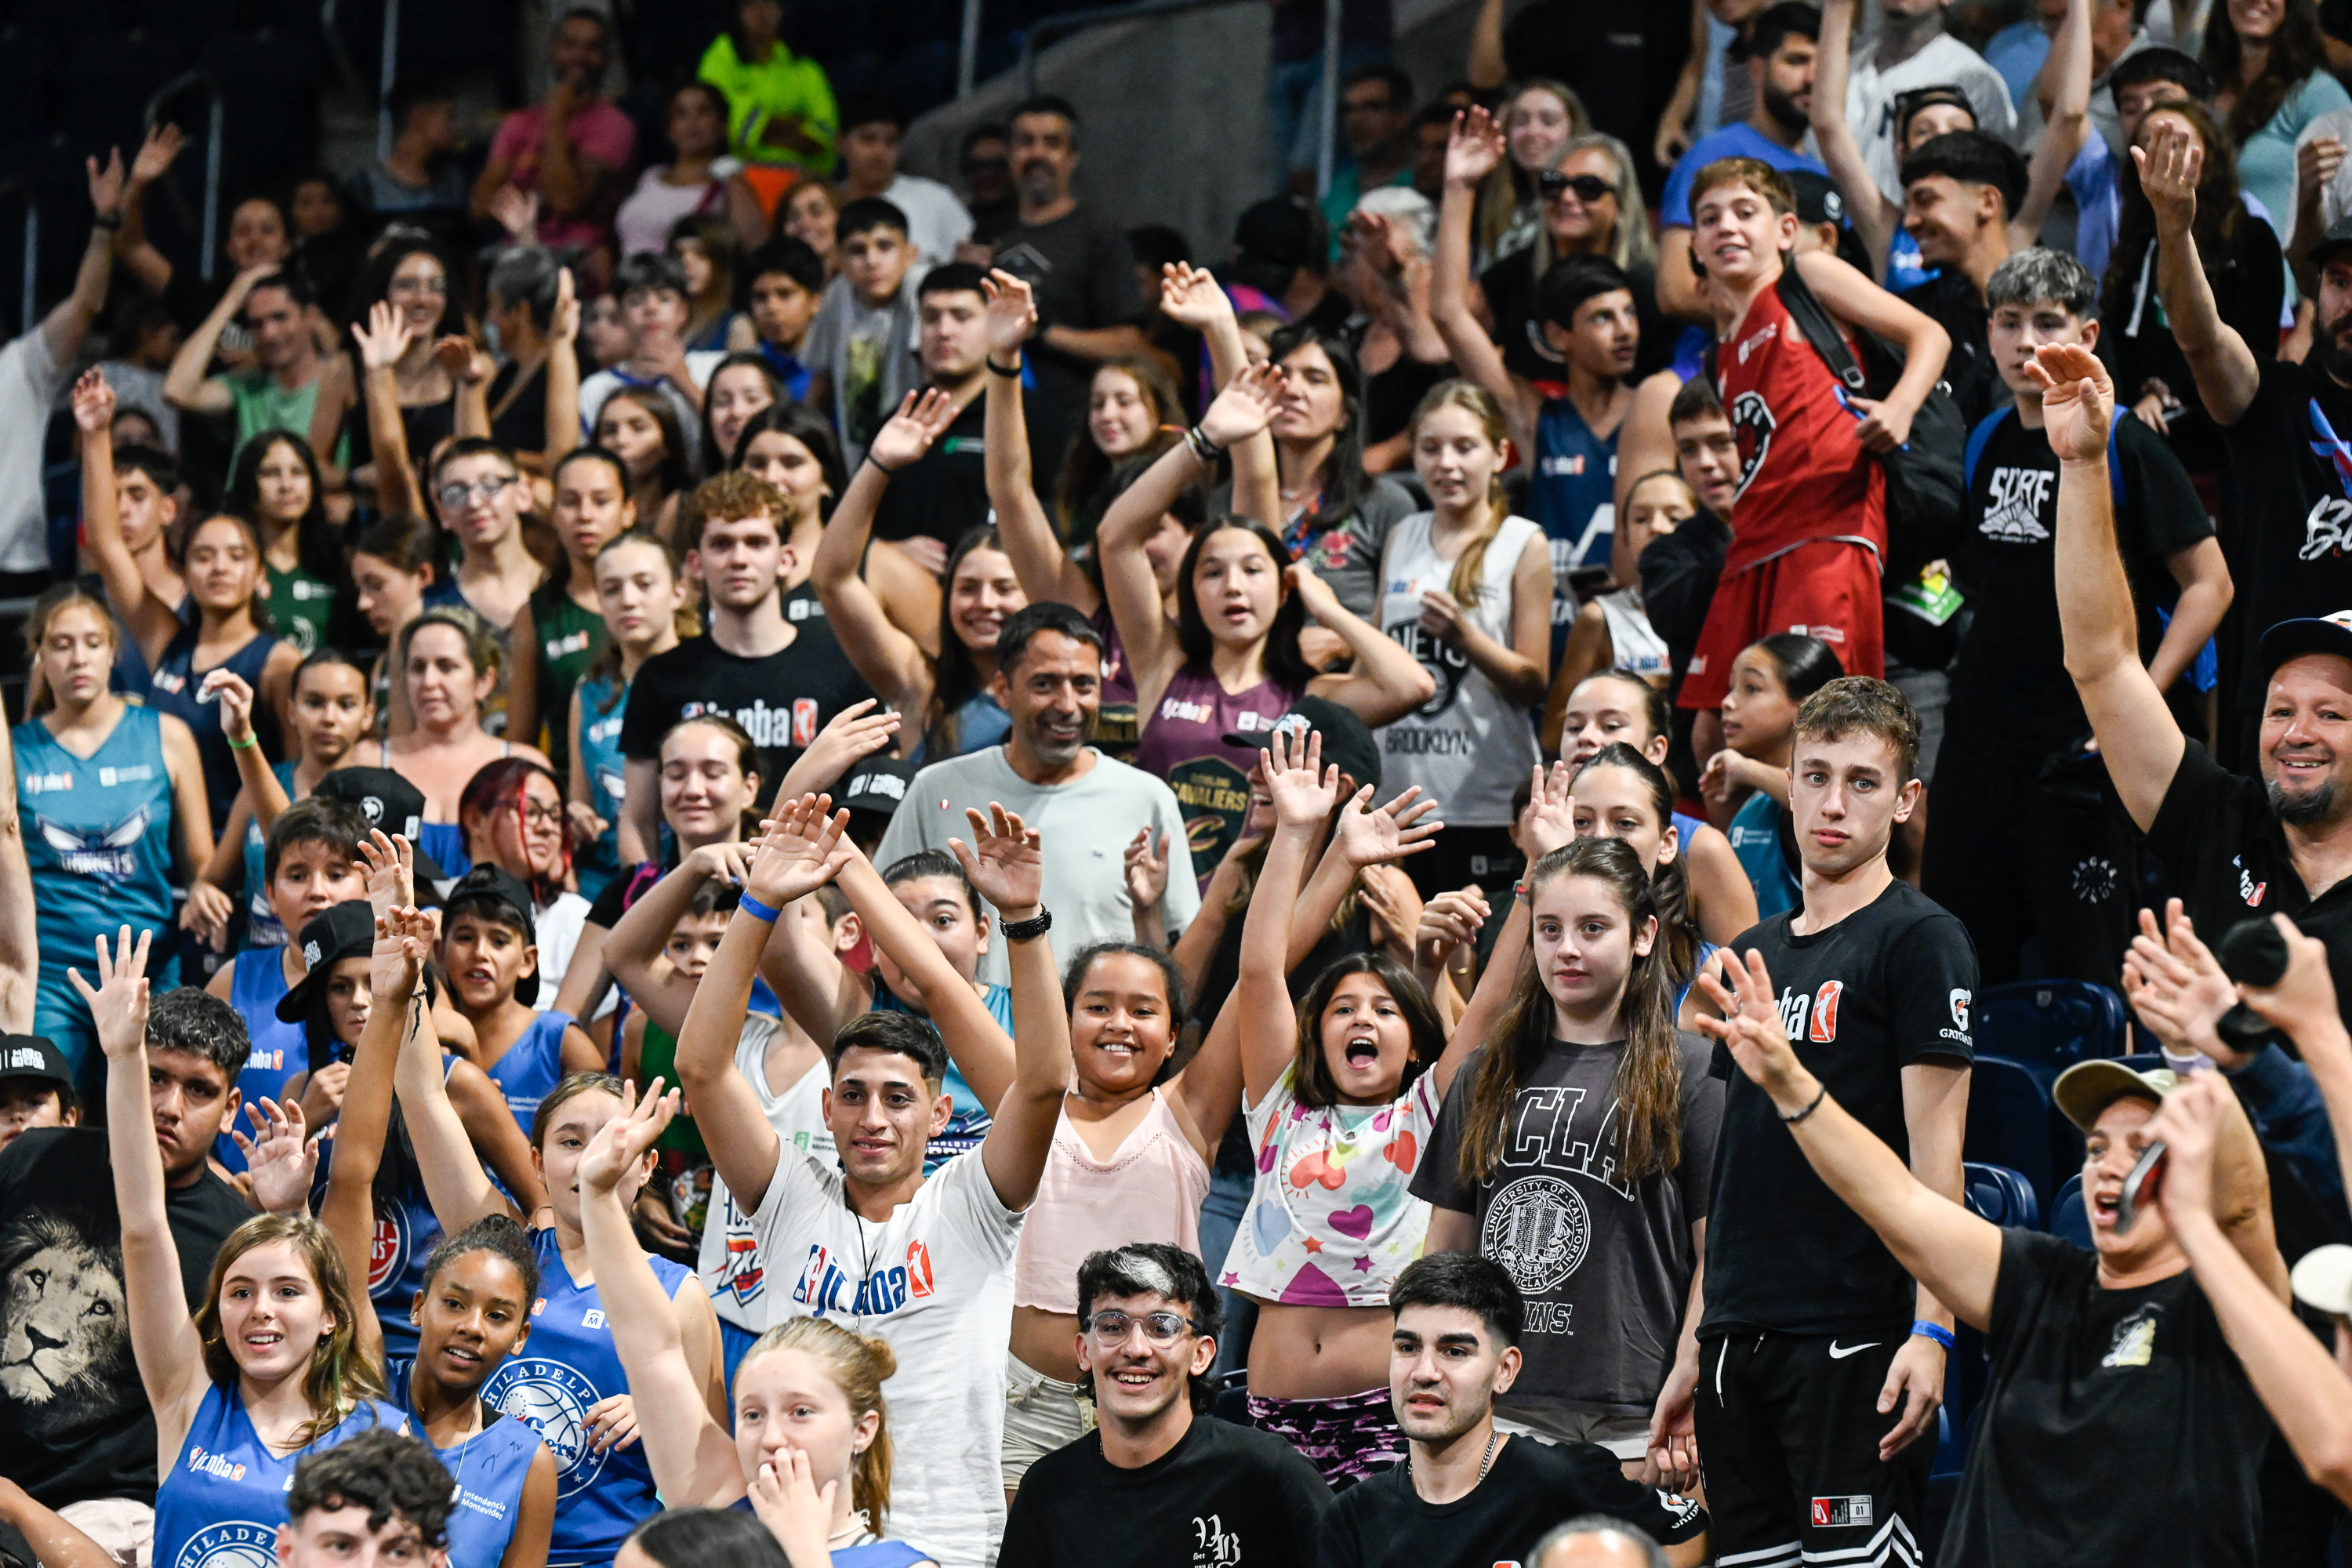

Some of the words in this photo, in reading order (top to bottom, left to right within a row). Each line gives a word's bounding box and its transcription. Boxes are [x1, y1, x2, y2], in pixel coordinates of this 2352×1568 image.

[1984, 466, 2055, 519] SURF
[1482, 1087, 1629, 1199] CLA
[1549, 1184, 1566, 1196] OF
[1488, 1181, 1543, 1233] UNIVERSITY
[1555, 1199, 1584, 1272] CALIFORNIA
[1543, 1250, 1560, 1259] LIGHT
[460, 1497, 503, 1521] Montevideo
[463, 1489, 506, 1512] Intendencia
[1855, 1505, 1864, 1515] 01
